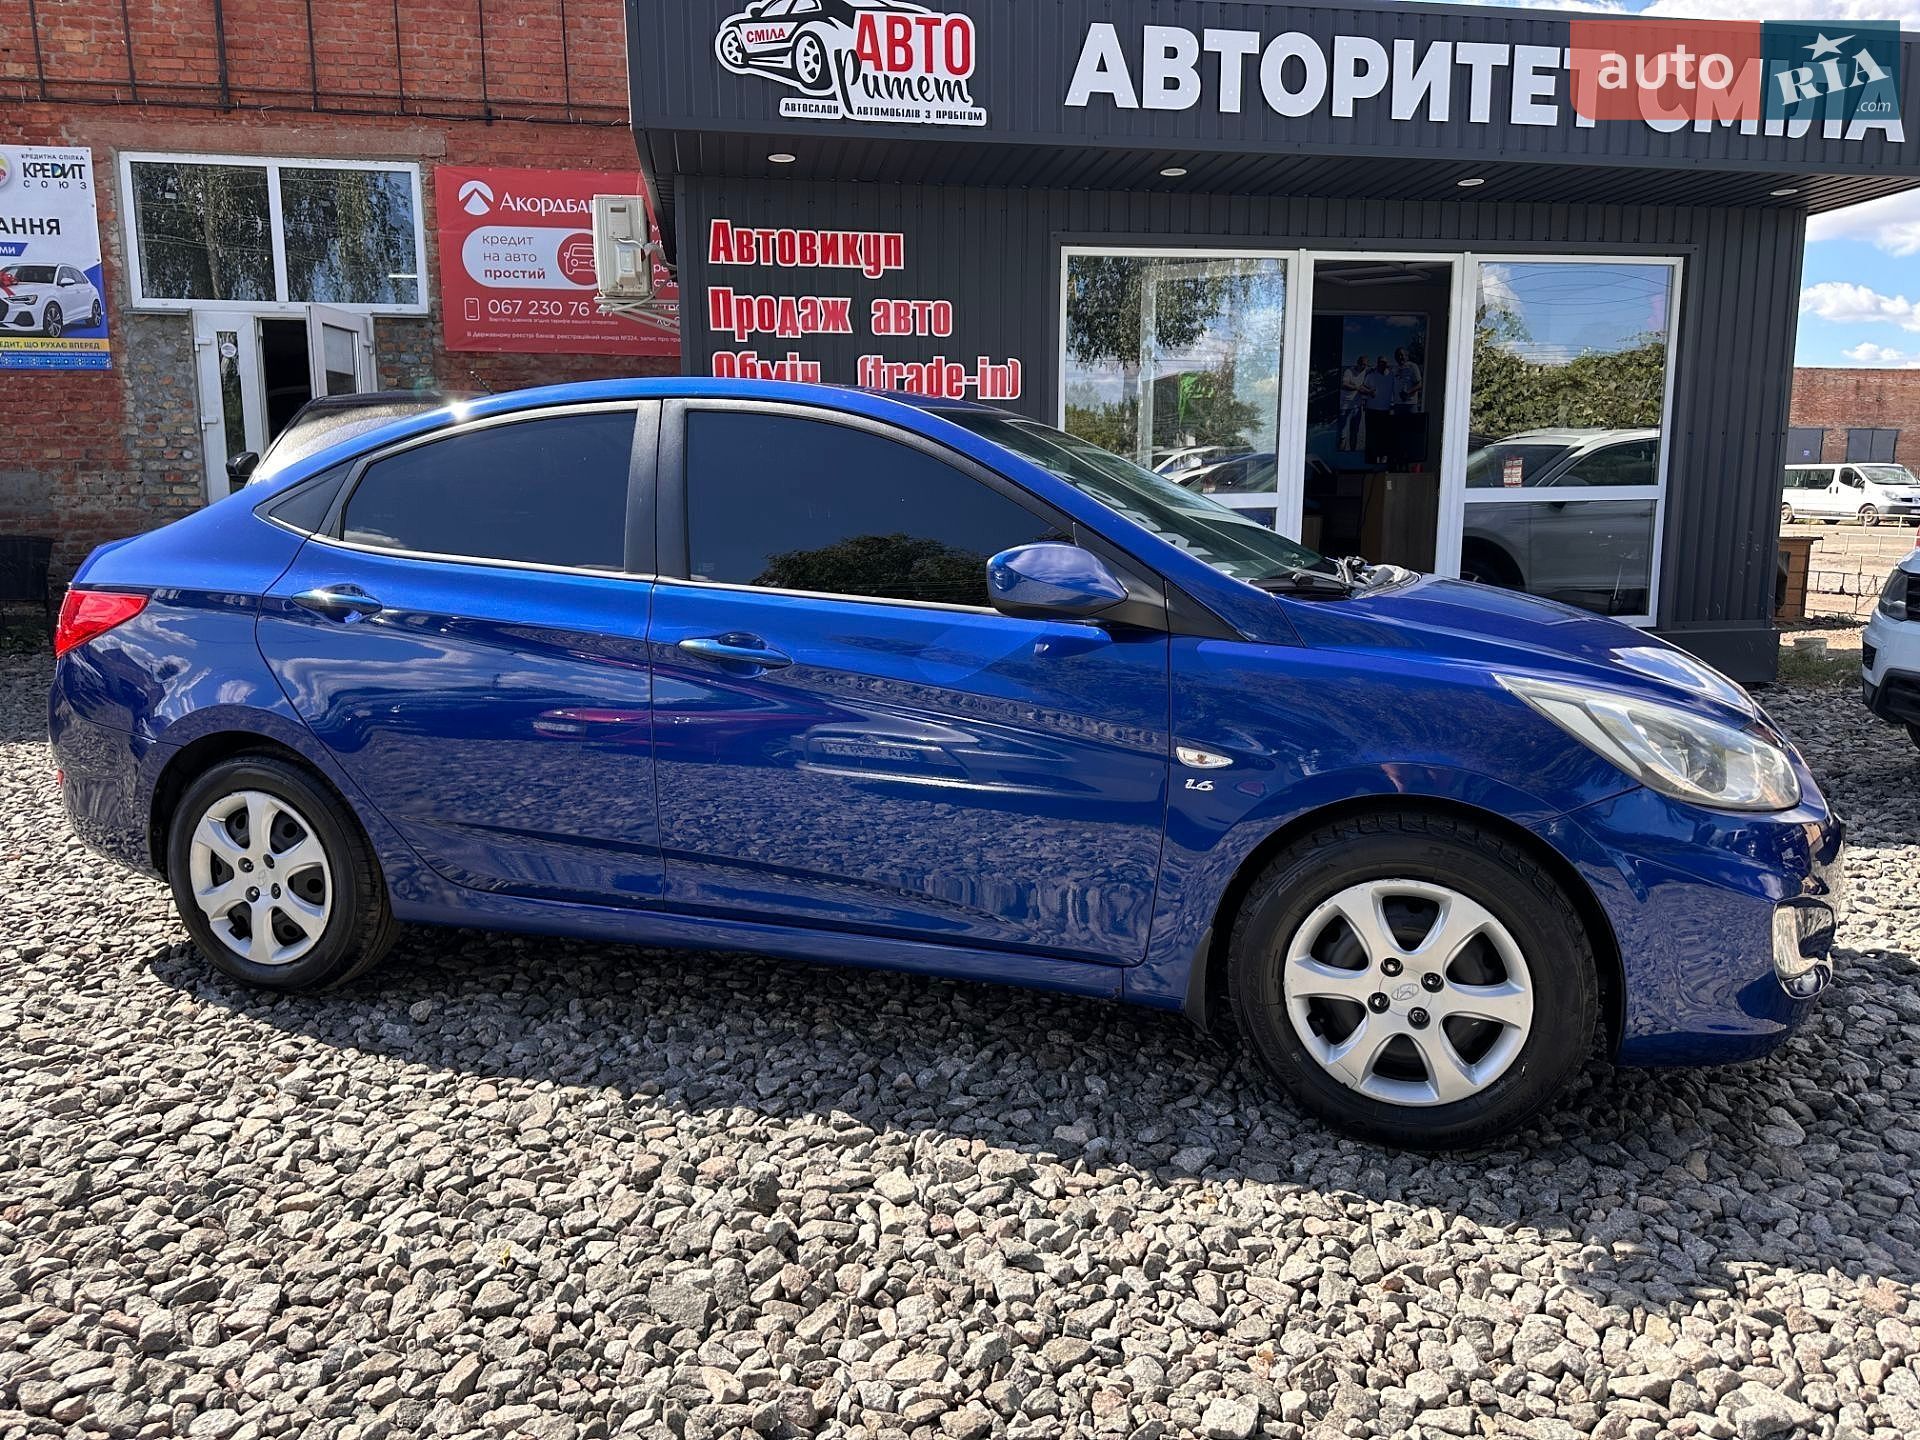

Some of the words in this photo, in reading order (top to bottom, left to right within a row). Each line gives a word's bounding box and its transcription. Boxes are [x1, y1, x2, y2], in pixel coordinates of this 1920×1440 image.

[746, 26, 786, 44] СМІЛА
[855, 13, 972, 76] АВТО
[1064, 21, 1616, 129] АВТОРИТЕТ
[1637, 51, 1906, 143] СМІЛА
[784, 102, 840, 115] АВТОСАЛОН
[856, 105, 921, 119] АВТОМОБІЛІВ
[935, 110, 983, 121] ПРОБІГОМ
[482, 235, 535, 247] кредит
[708, 219, 905, 279] Автовикуп
[483, 252, 500, 262] на
[504, 252, 538, 263] авто
[484, 267, 546, 281] простий
[487, 300, 522, 315] 067
[527, 301, 563, 316] 230
[568, 301, 591, 317] 76
[707, 286, 853, 342] Продаж
[870, 299, 953, 338] авто
[856, 354, 1023, 400] (trade-in)
